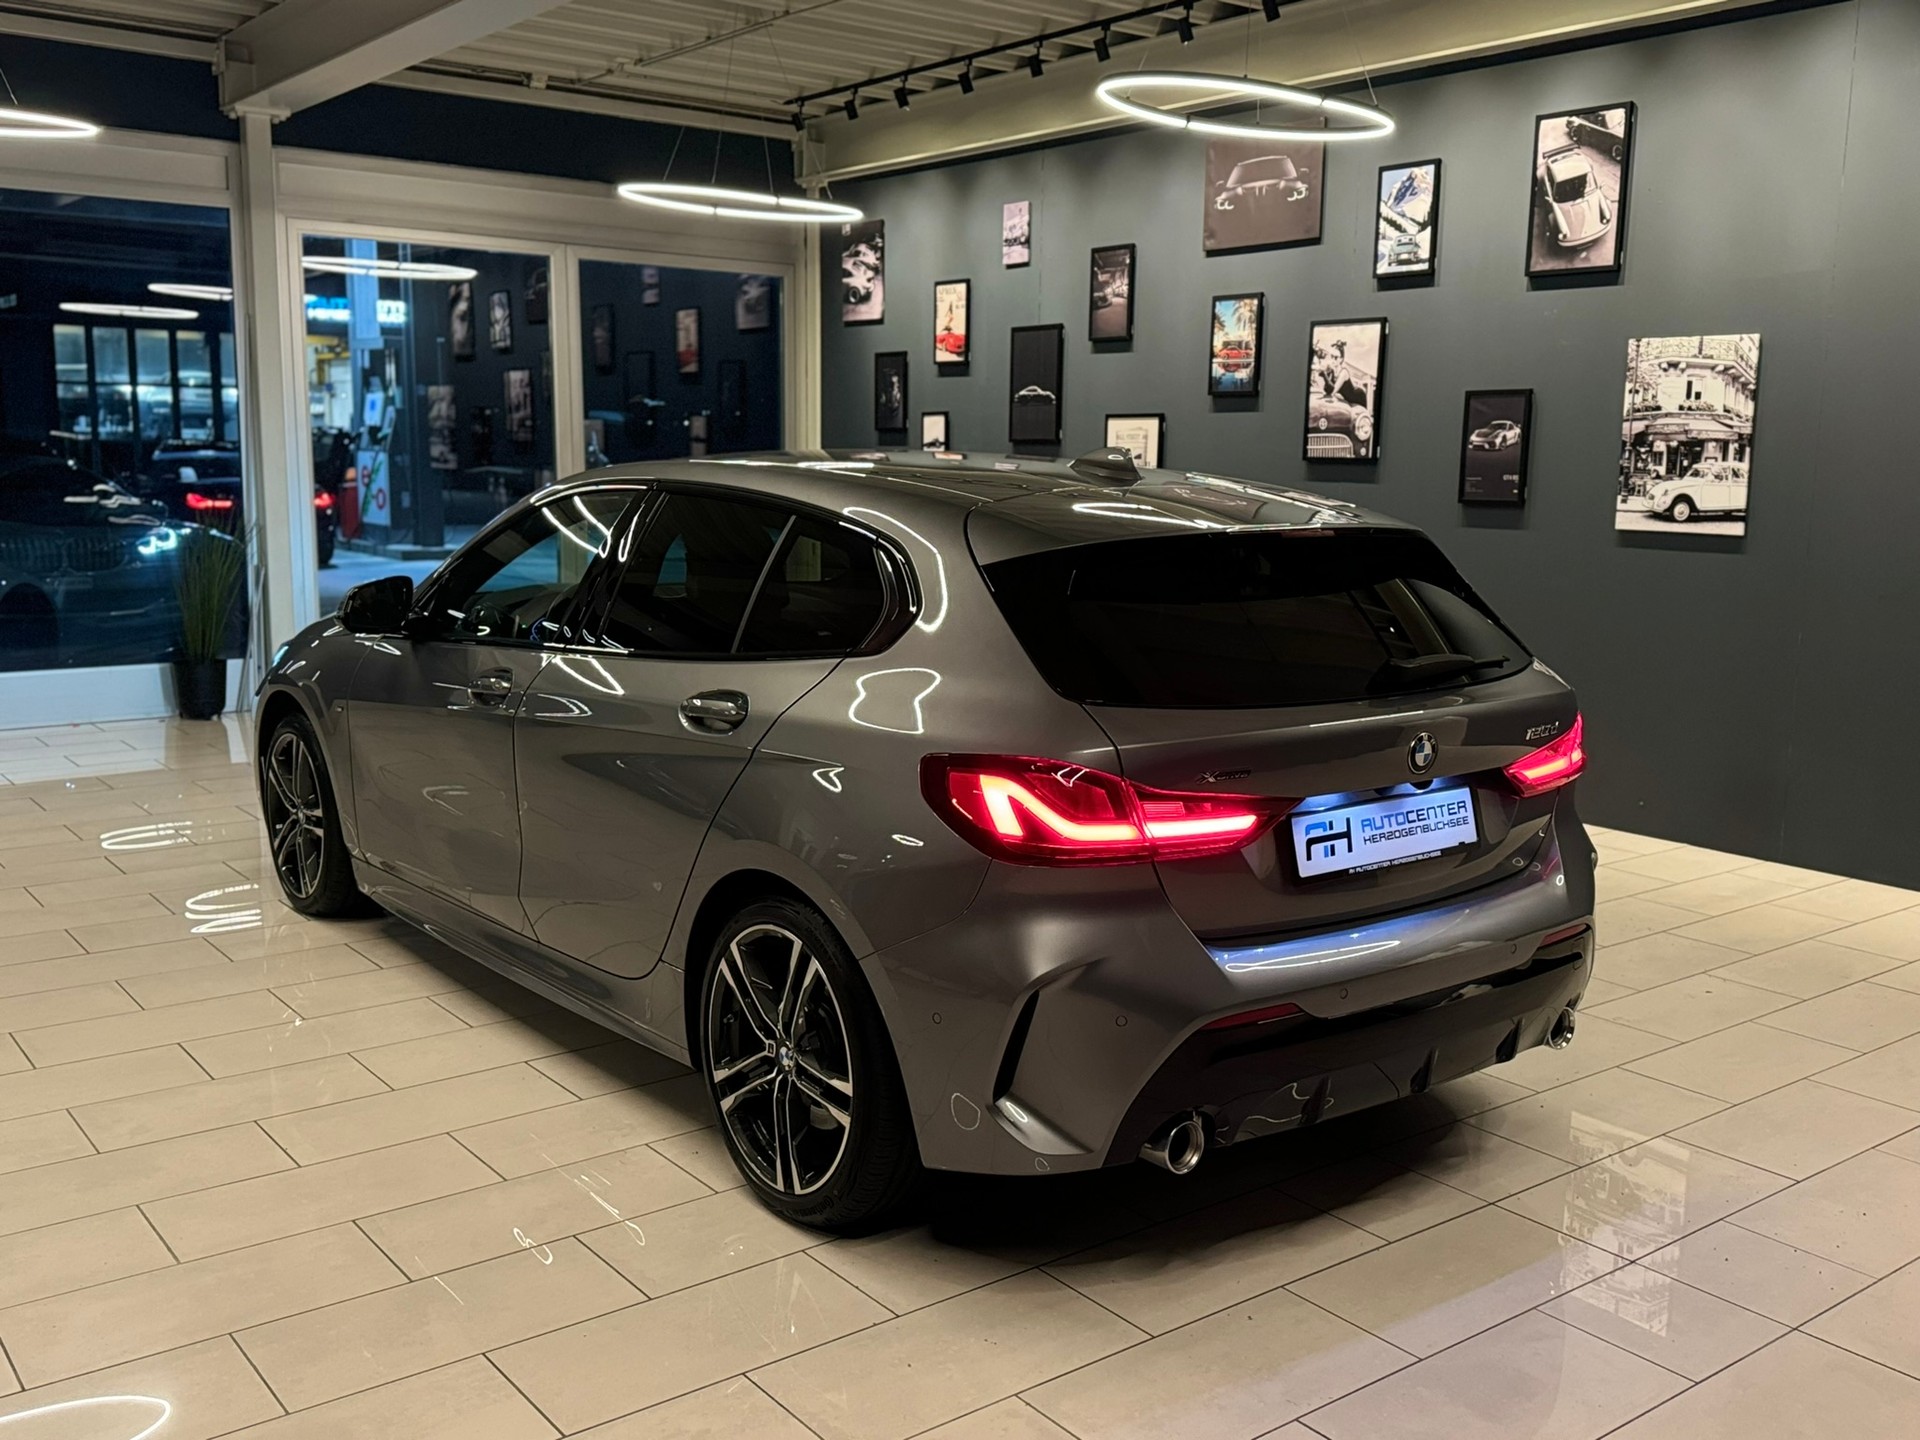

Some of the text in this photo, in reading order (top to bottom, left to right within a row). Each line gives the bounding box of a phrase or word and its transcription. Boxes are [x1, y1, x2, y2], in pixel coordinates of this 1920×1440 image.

[1525, 722, 1559, 741] 120d
[1361, 800, 1468, 834] AUTOCENTER
[1363, 815, 1469, 845] HERZOGENBUCHSEE
[1356, 860, 1391, 874] AUTOCENTER
[1391, 850, 1442, 866] HERZOGENBUCHSEE
